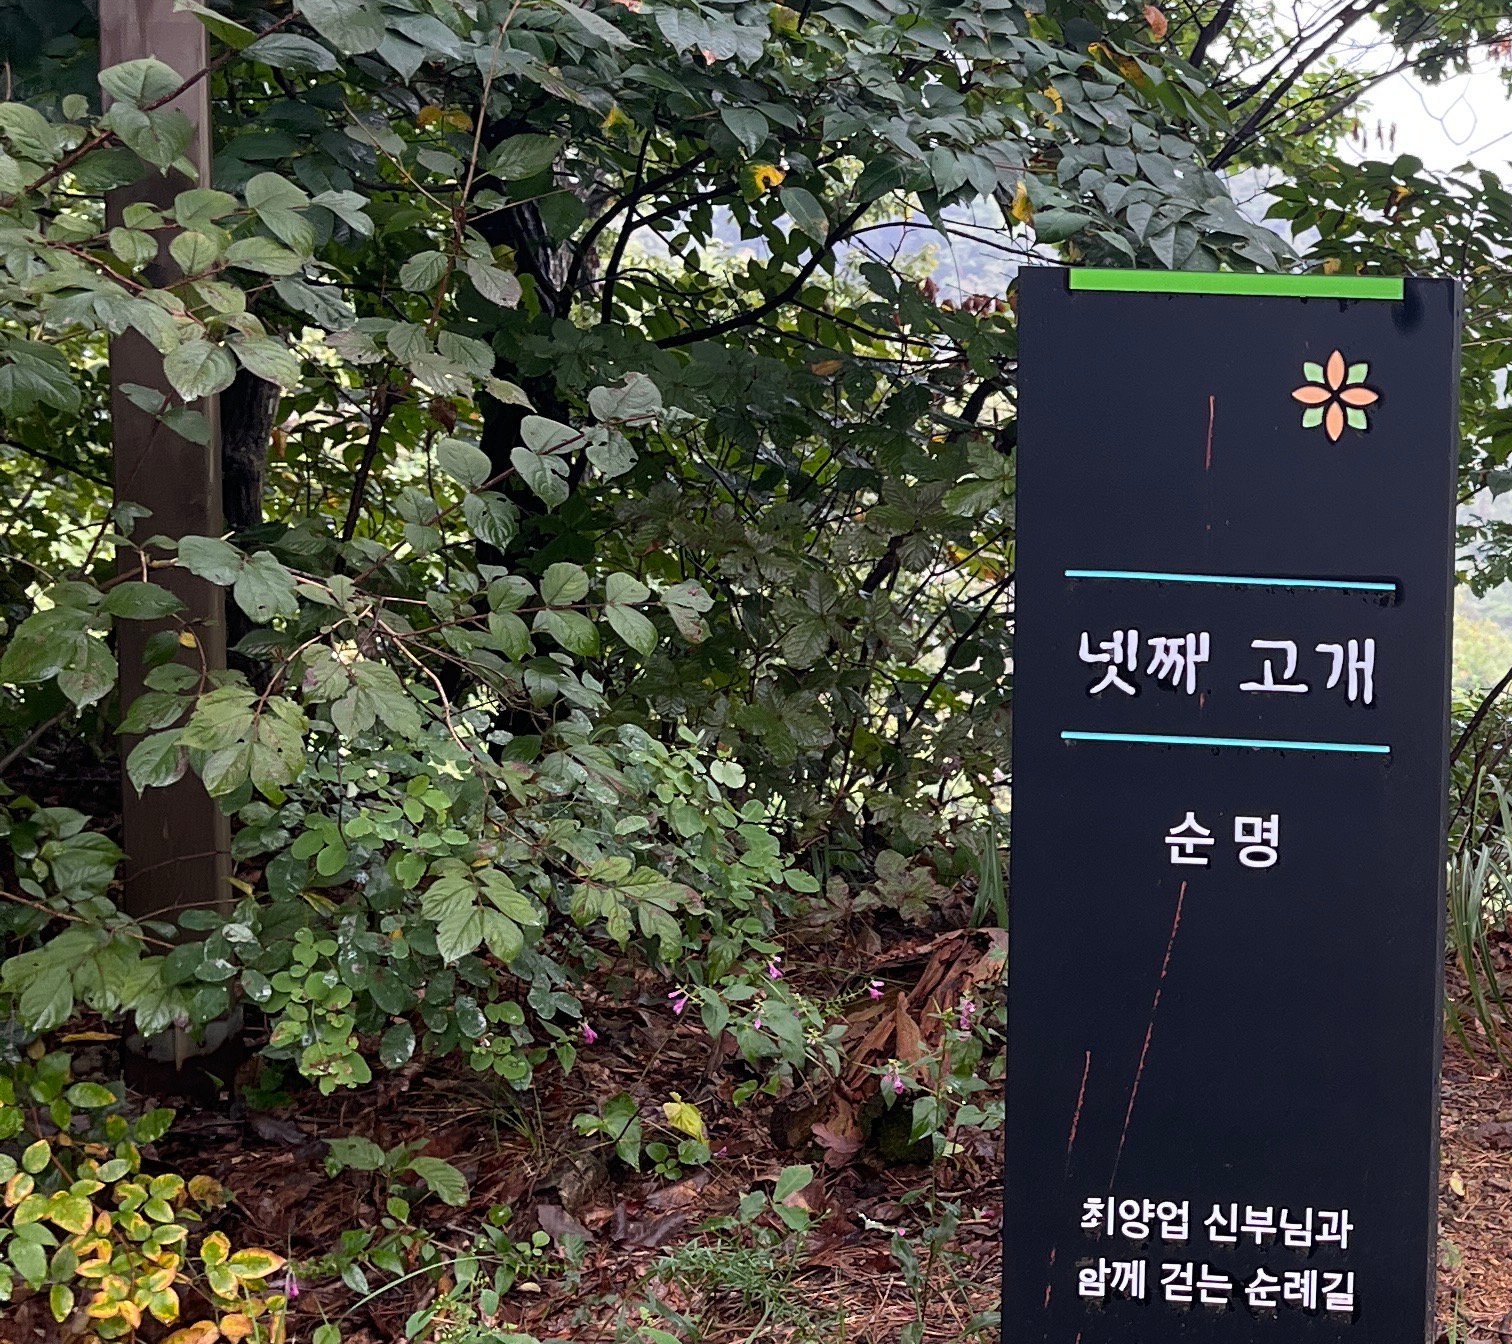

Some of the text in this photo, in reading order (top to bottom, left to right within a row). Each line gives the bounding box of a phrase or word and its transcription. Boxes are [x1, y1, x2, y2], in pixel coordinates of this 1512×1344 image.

[1078, 629, 1375, 705] 넷째 고개
[1080, 1196, 1354, 1250] 최양업 신부님과
[1160, 1262, 1233, 1304] 걷는
[1244, 1267, 1355, 1312] 순례길
